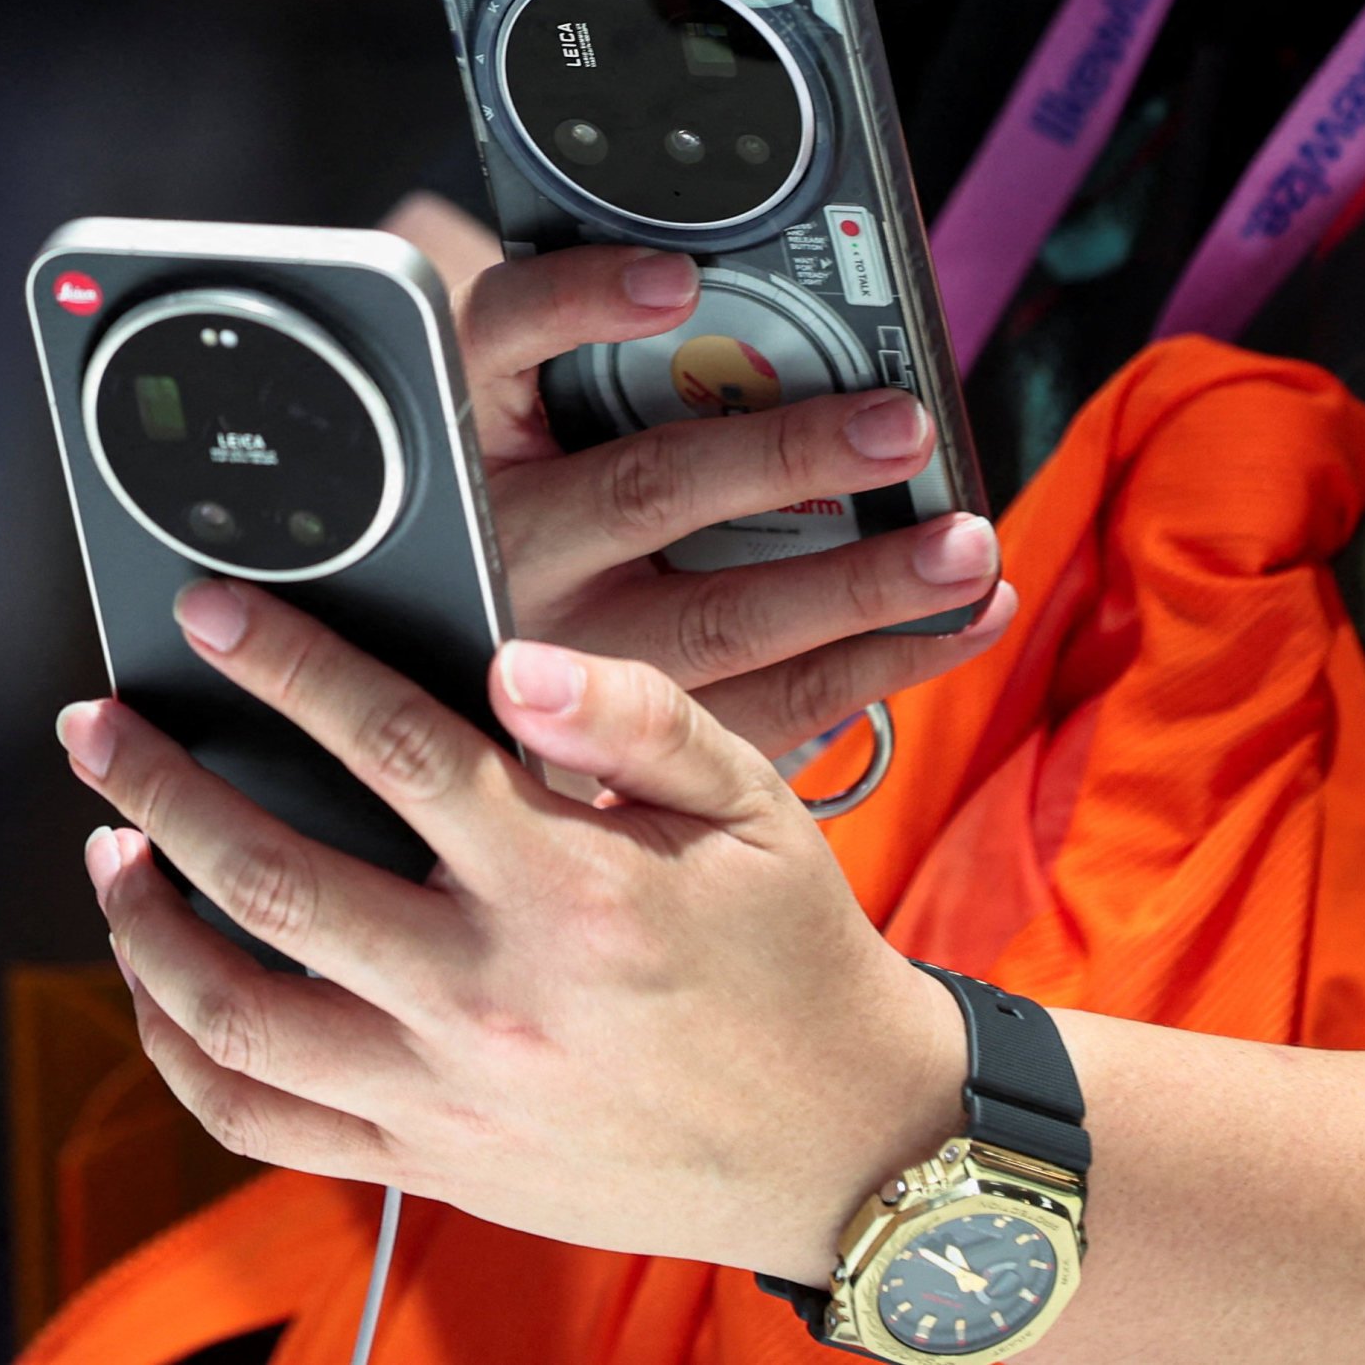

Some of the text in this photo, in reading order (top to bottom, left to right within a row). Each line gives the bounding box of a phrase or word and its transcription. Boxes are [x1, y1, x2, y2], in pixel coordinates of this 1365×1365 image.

[557, 22, 582, 67] LEICA
[854, 259, 871, 297] TO TALK
[217, 432, 267, 450] LEICA
